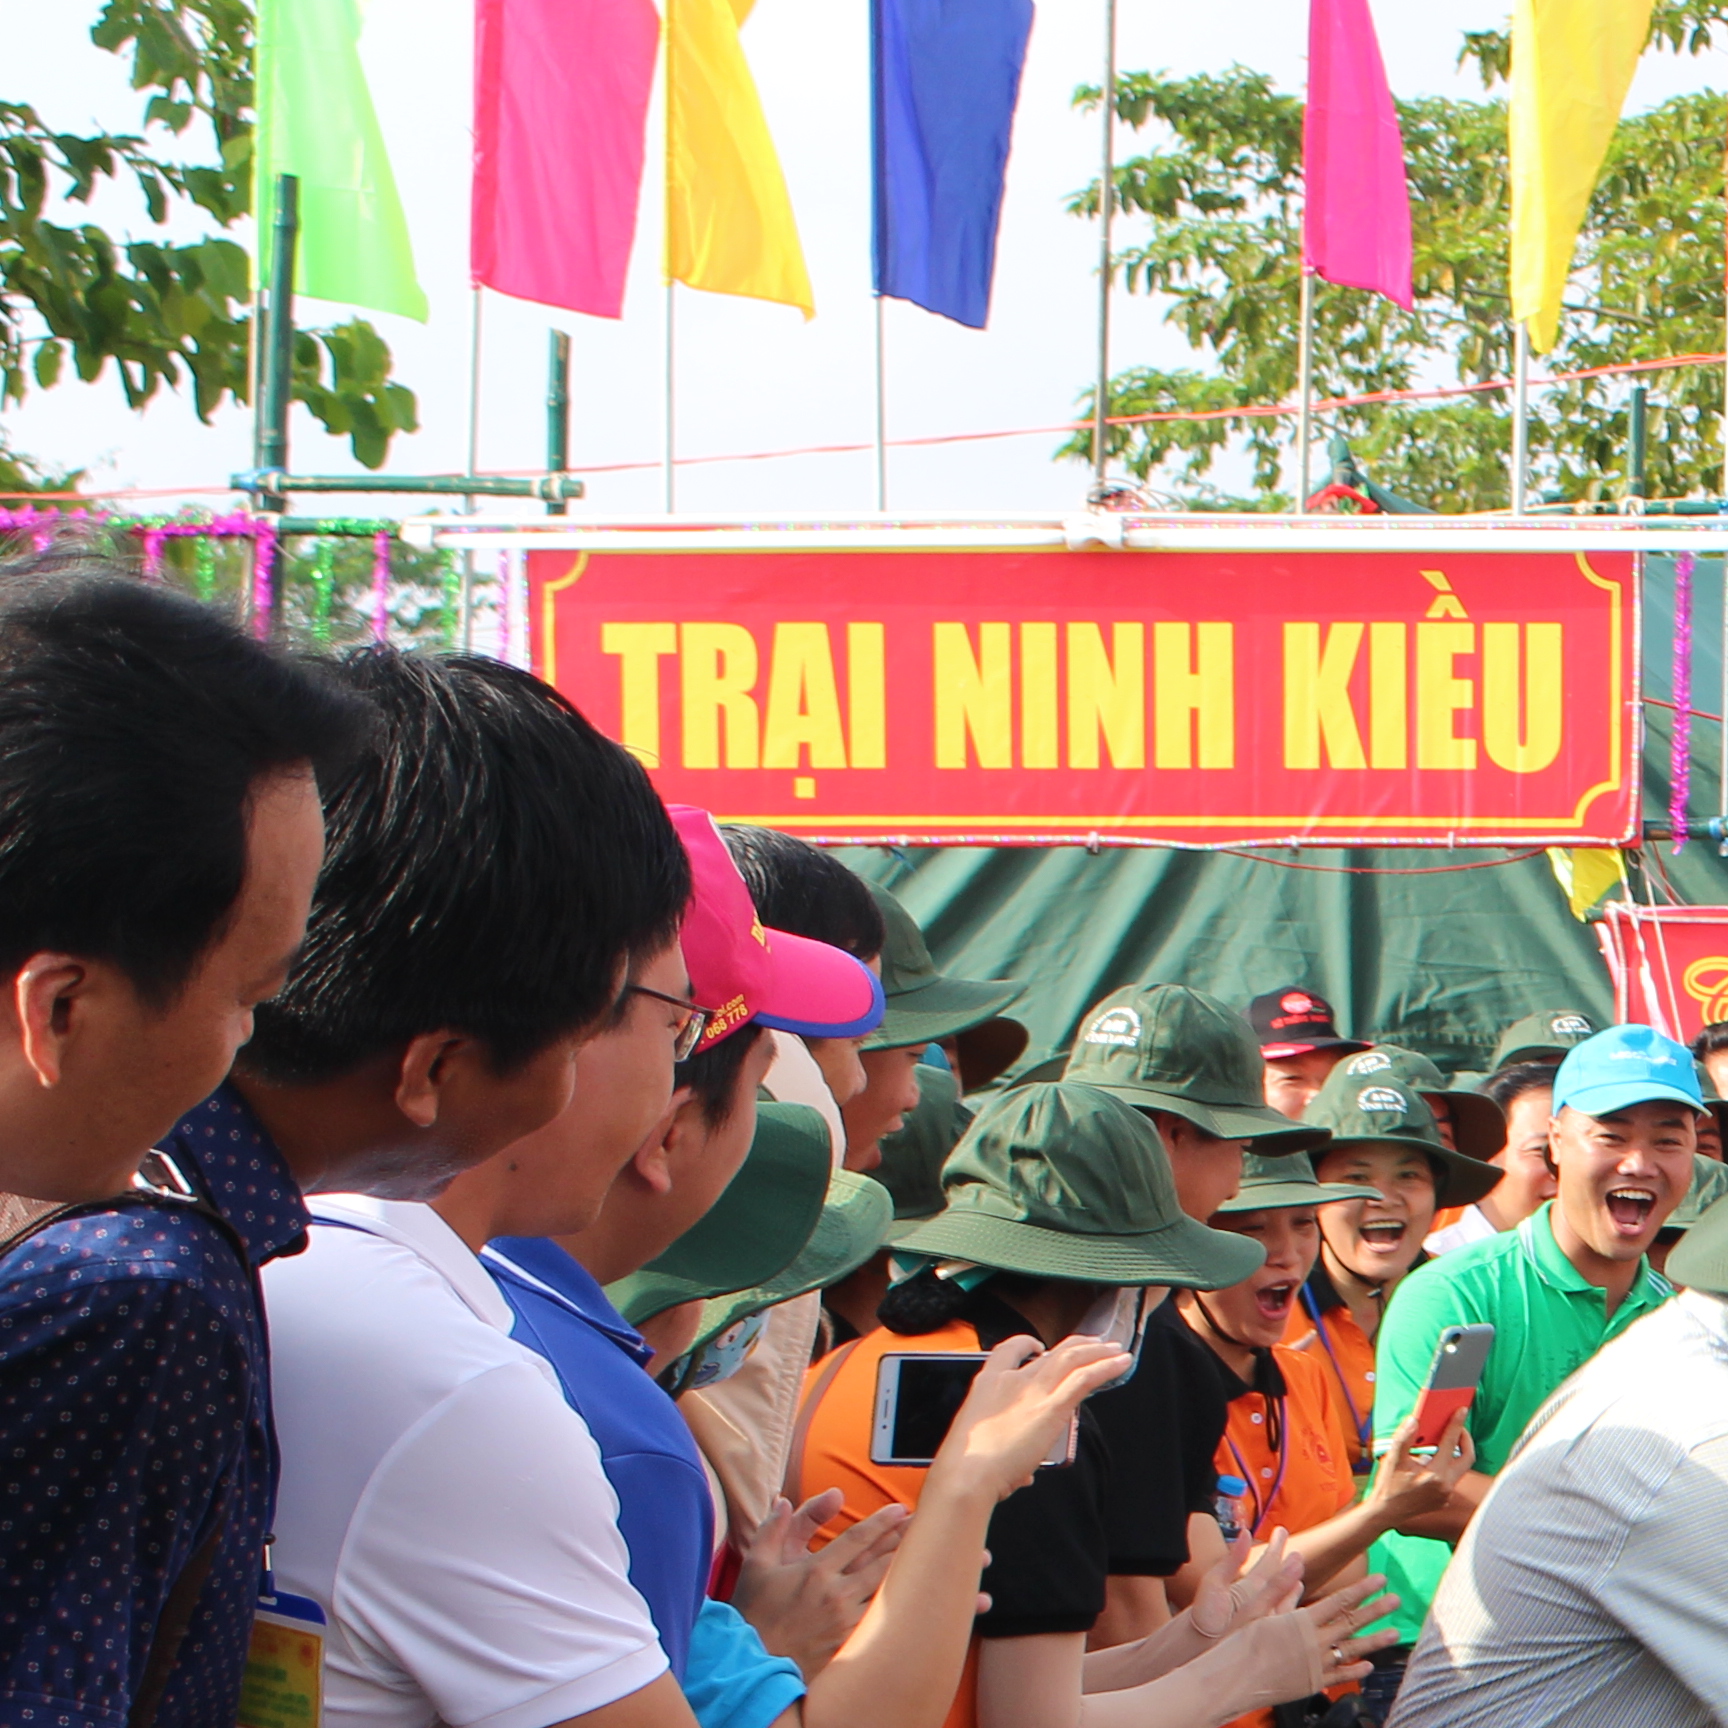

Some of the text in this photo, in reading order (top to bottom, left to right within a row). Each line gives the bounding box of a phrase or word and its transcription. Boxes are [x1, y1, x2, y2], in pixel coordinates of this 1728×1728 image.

[600, 570, 1563, 799] TRẠI NINH KIỀU
[706, 1018, 728, 1039] 068
